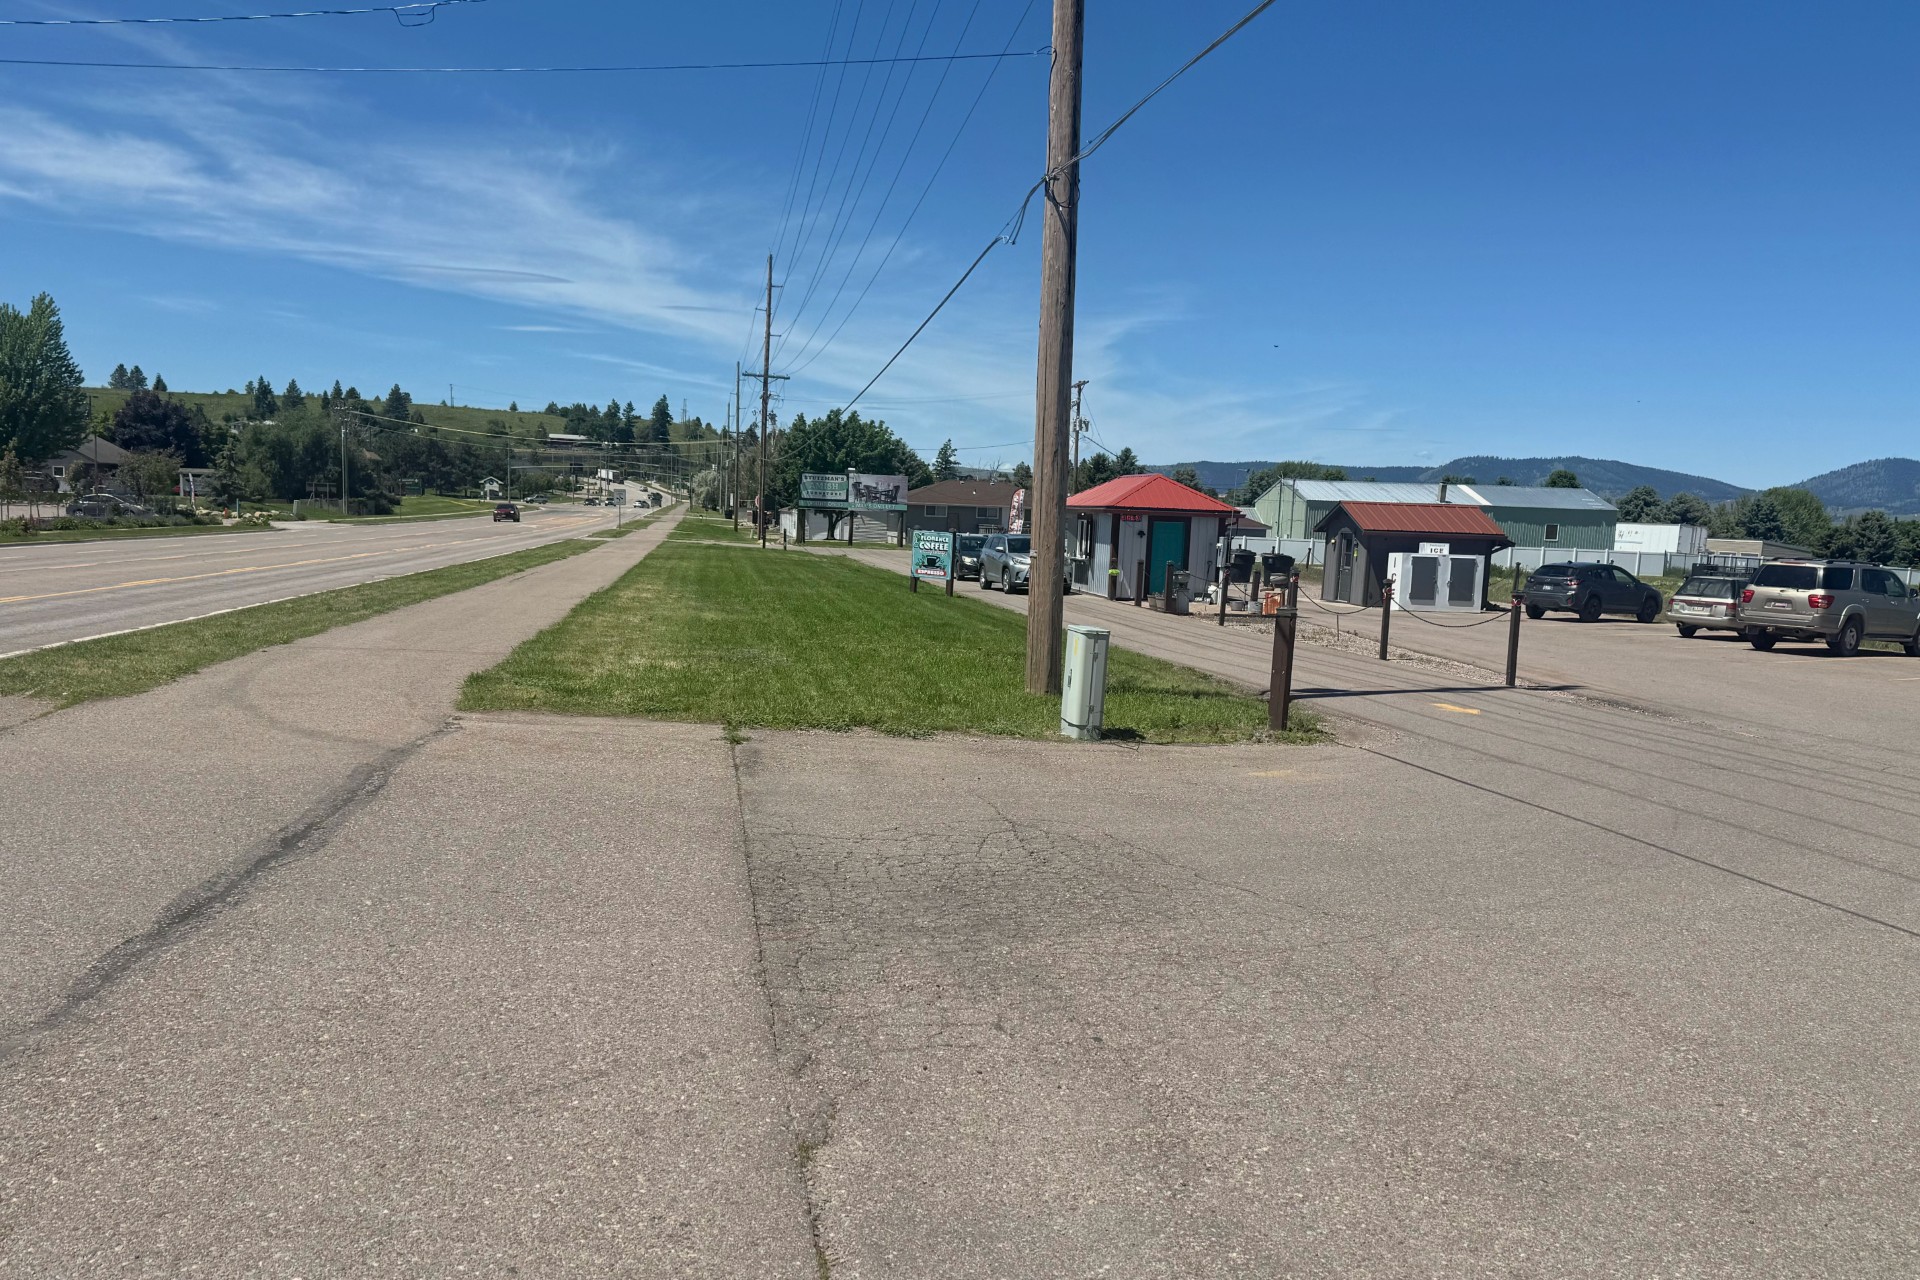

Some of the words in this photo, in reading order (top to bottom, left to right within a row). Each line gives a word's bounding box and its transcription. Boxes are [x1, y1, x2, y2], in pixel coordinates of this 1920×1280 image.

[809, 482, 839, 490] AMISH
[920, 535, 949, 543] FLORENCE
[919, 541, 949, 551] COFFEE
